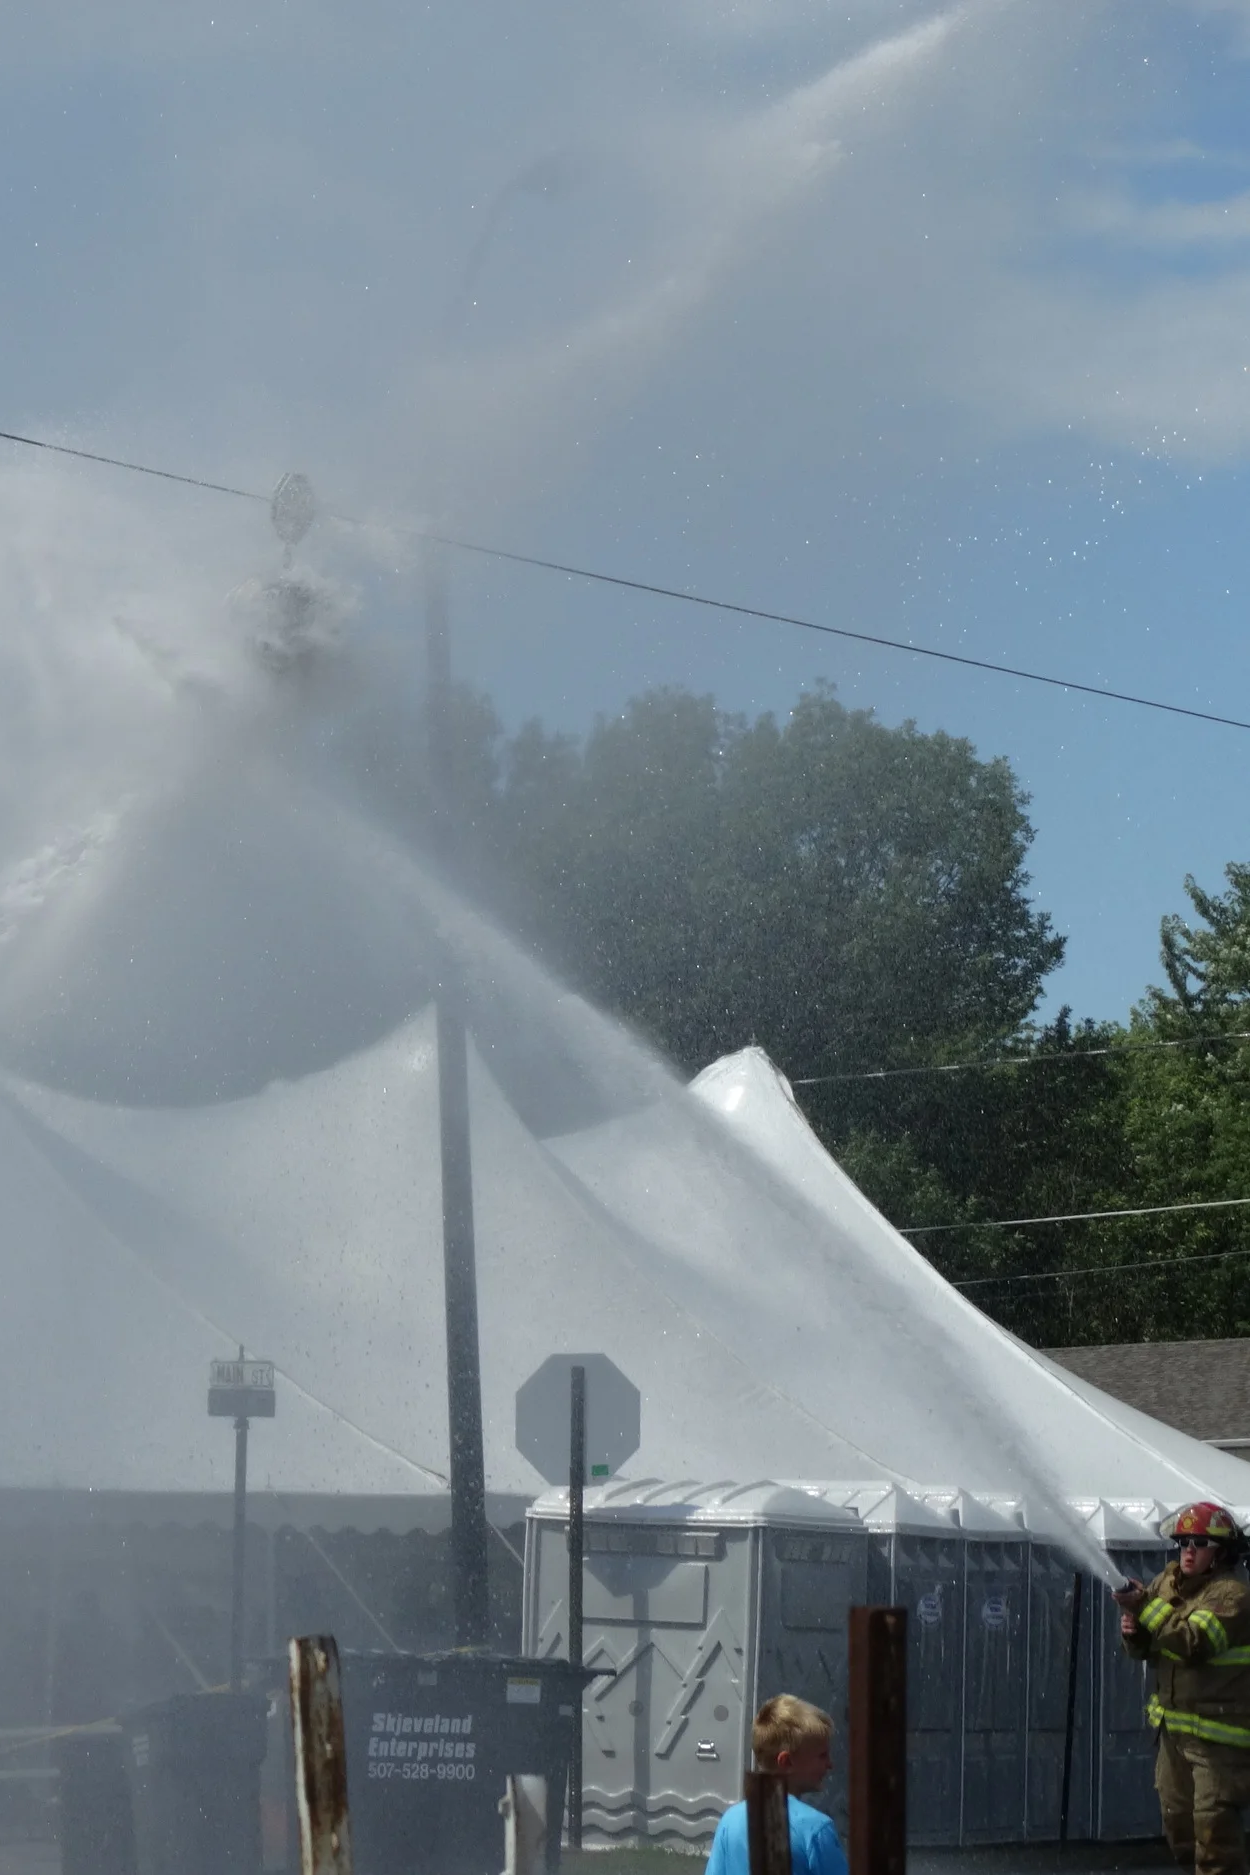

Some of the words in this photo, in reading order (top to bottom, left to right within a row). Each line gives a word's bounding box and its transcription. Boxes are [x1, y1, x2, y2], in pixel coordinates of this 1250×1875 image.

[372, 1712, 473, 1736] Skjeveland
[368, 1737, 476, 1761] Enterprises
[368, 1762, 476, 1780] 507-528-9900
